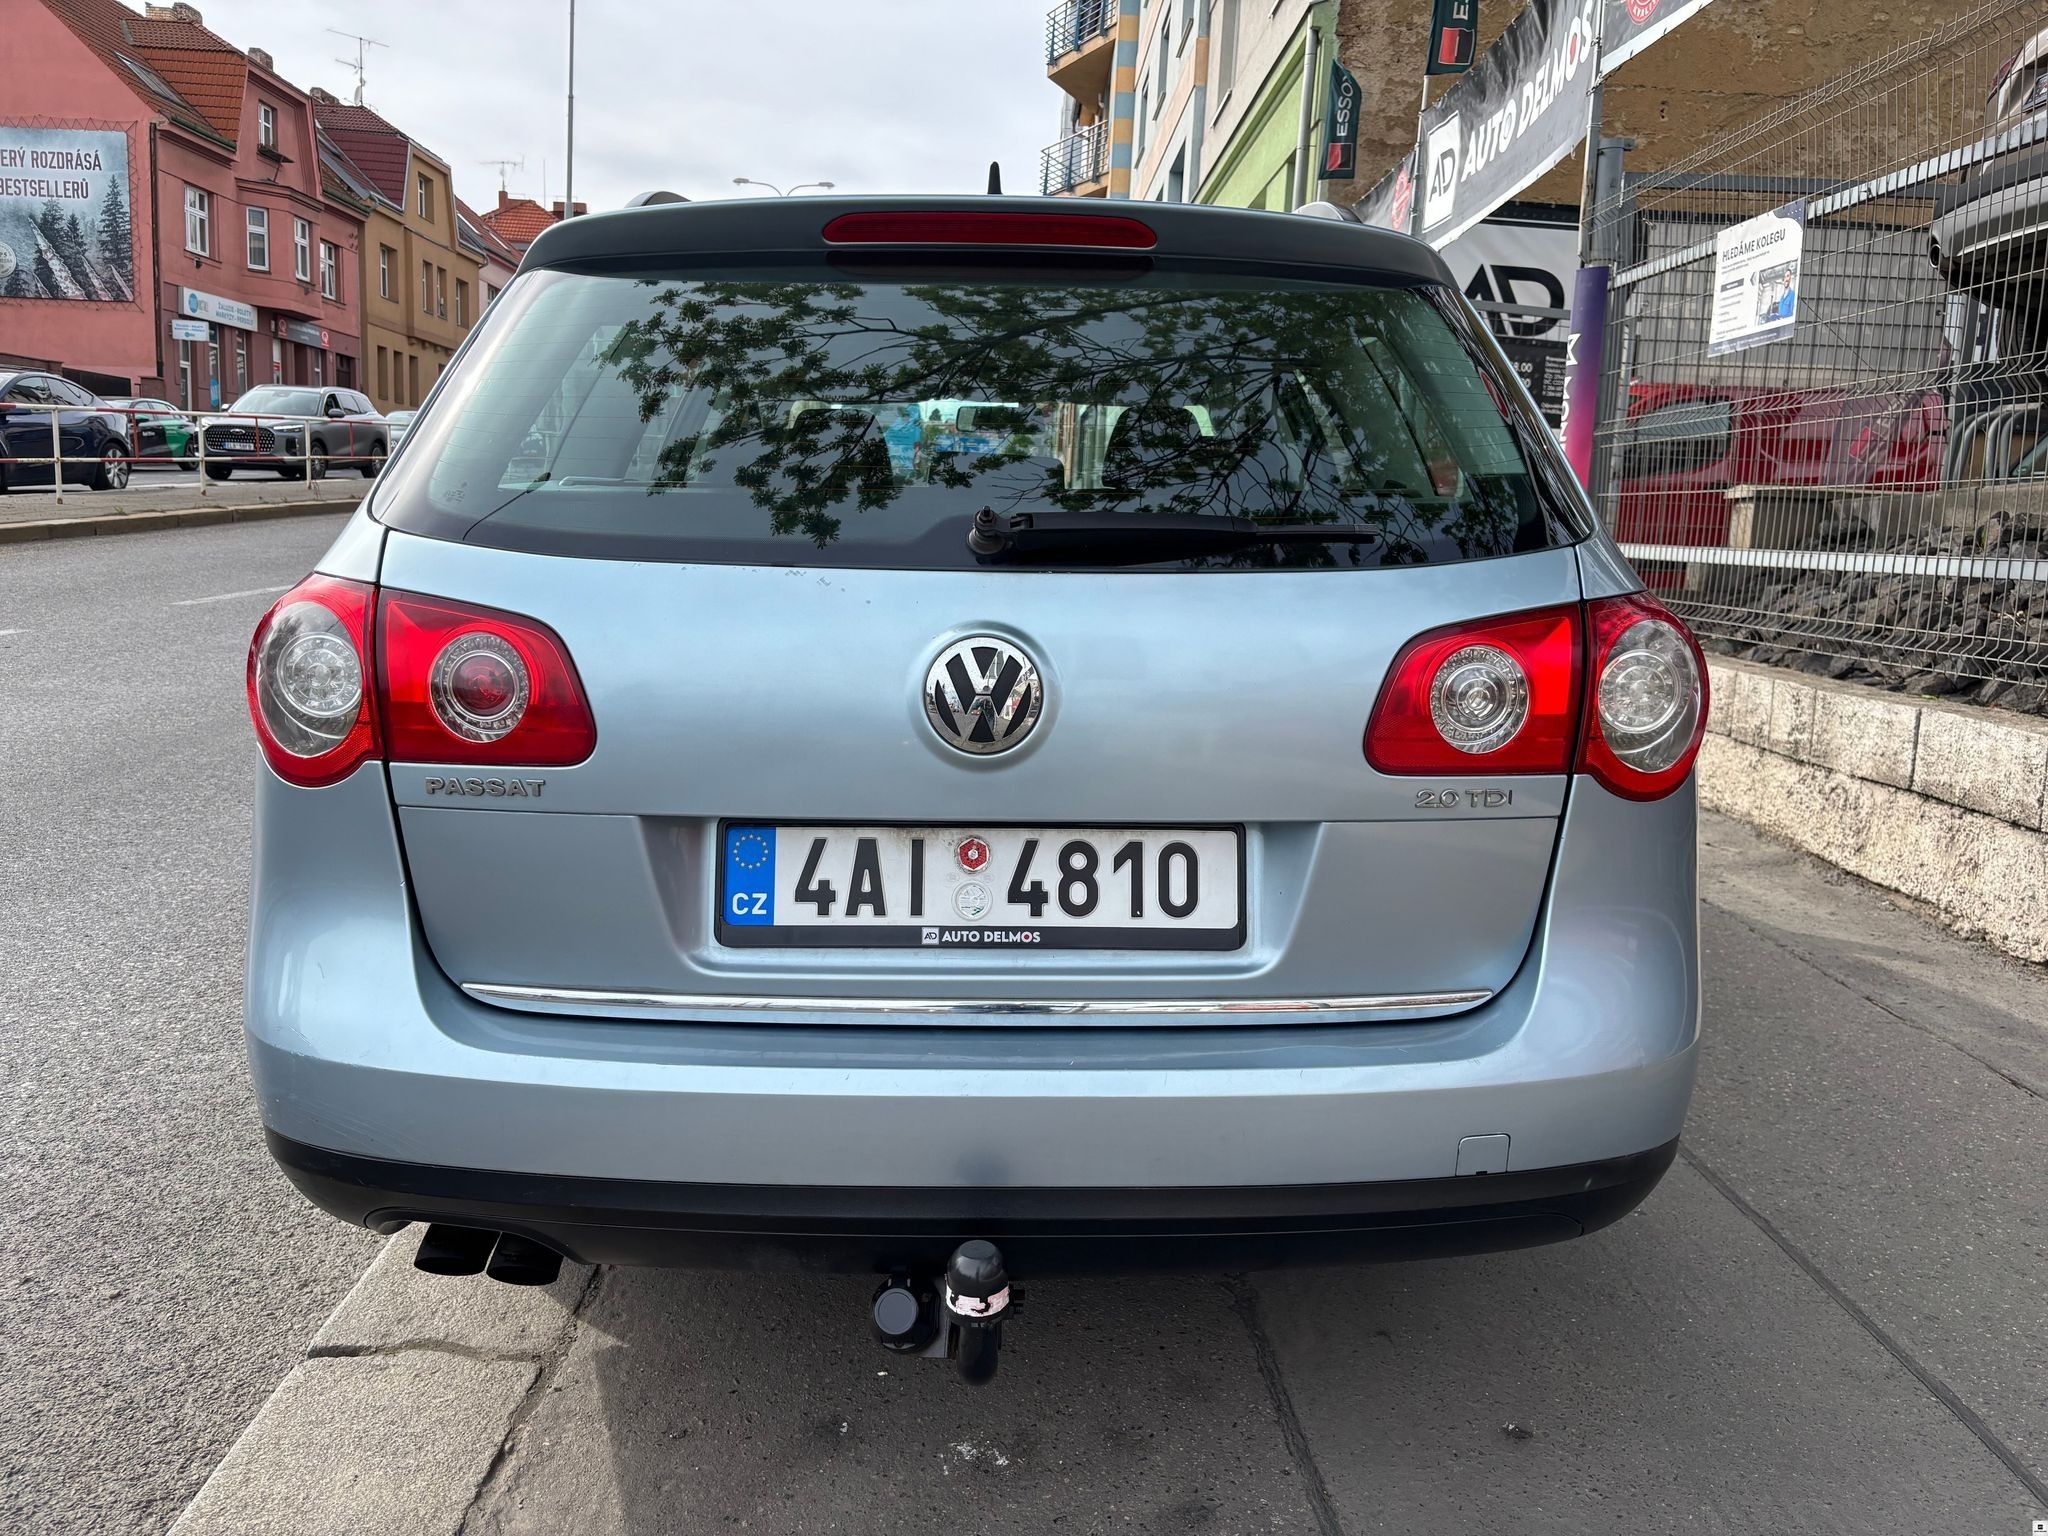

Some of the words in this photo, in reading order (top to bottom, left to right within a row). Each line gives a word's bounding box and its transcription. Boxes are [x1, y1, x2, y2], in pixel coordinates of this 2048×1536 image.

[1460, 98, 1517, 183] AUTO
[1516, 0, 1593, 139] DELMOS
[30, 148, 103, 171] ROZDRÁSÁ
[1722, 239, 1755, 262] HLEDÁME
[1755, 228, 1786, 250] KOLEGU
[425, 776, 546, 797] PASSAT
[1464, 788, 1513, 808] TDI
[794, 837, 925, 917] 4AI
[1006, 838, 1200, 918] 4810
[731, 892, 768, 915] CZ
[941, 930, 980, 942] AUTO
[983, 931, 1041, 943] DELMOS
